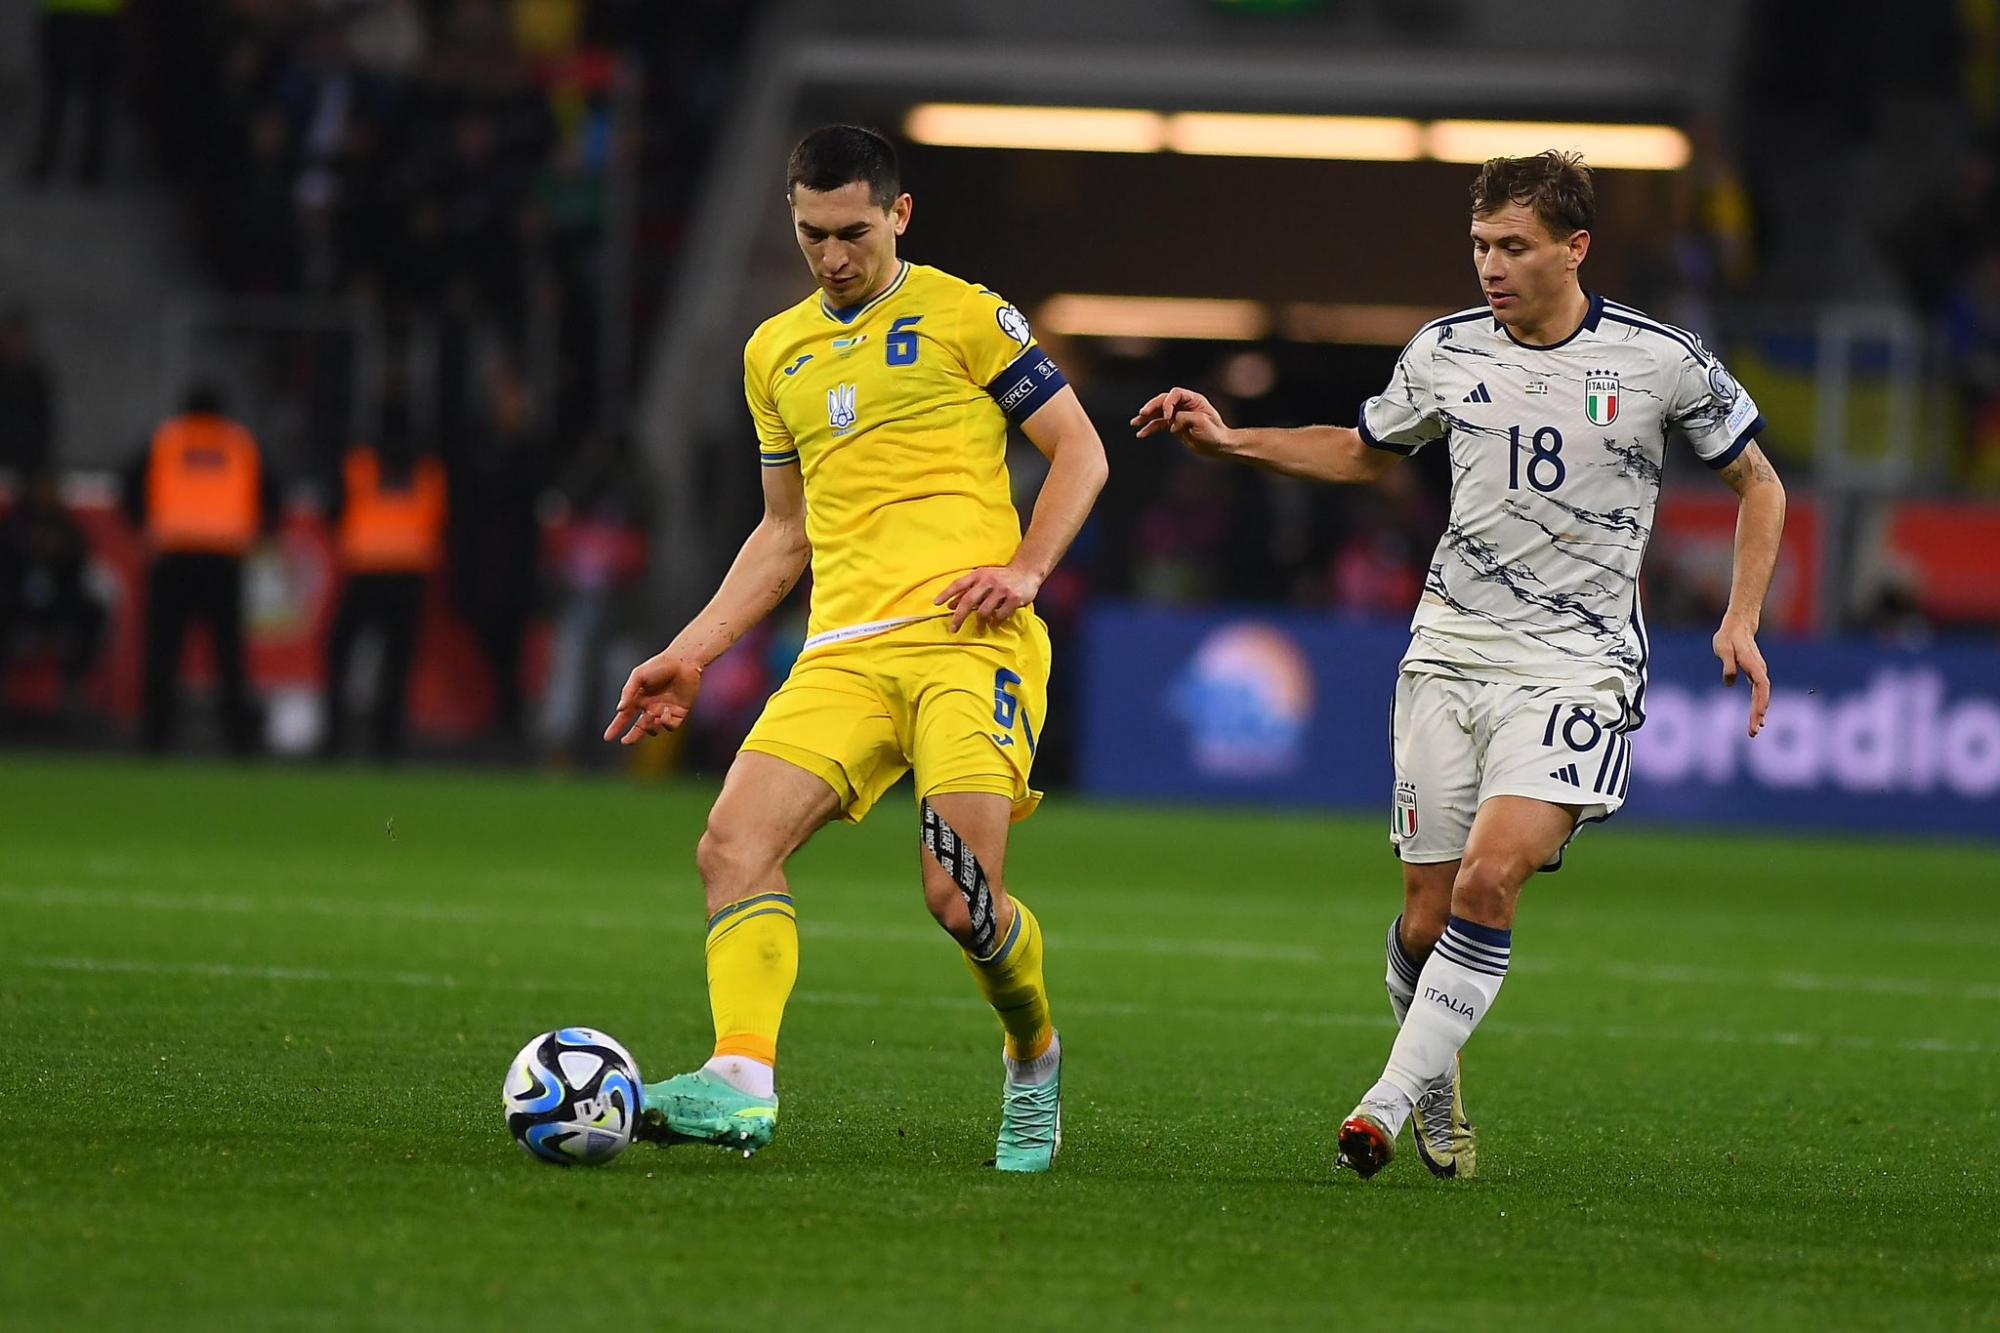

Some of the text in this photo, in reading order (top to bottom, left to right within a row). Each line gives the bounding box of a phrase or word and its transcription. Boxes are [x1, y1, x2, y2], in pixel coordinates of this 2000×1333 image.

[886, 314, 924, 367] 6
[1588, 381, 1617, 391] ITALIA
[1509, 425, 1566, 493] 18
[994, 668, 1022, 729] 6
[1542, 703, 1602, 753] 18
[1424, 986, 1475, 1021] ITALIA
